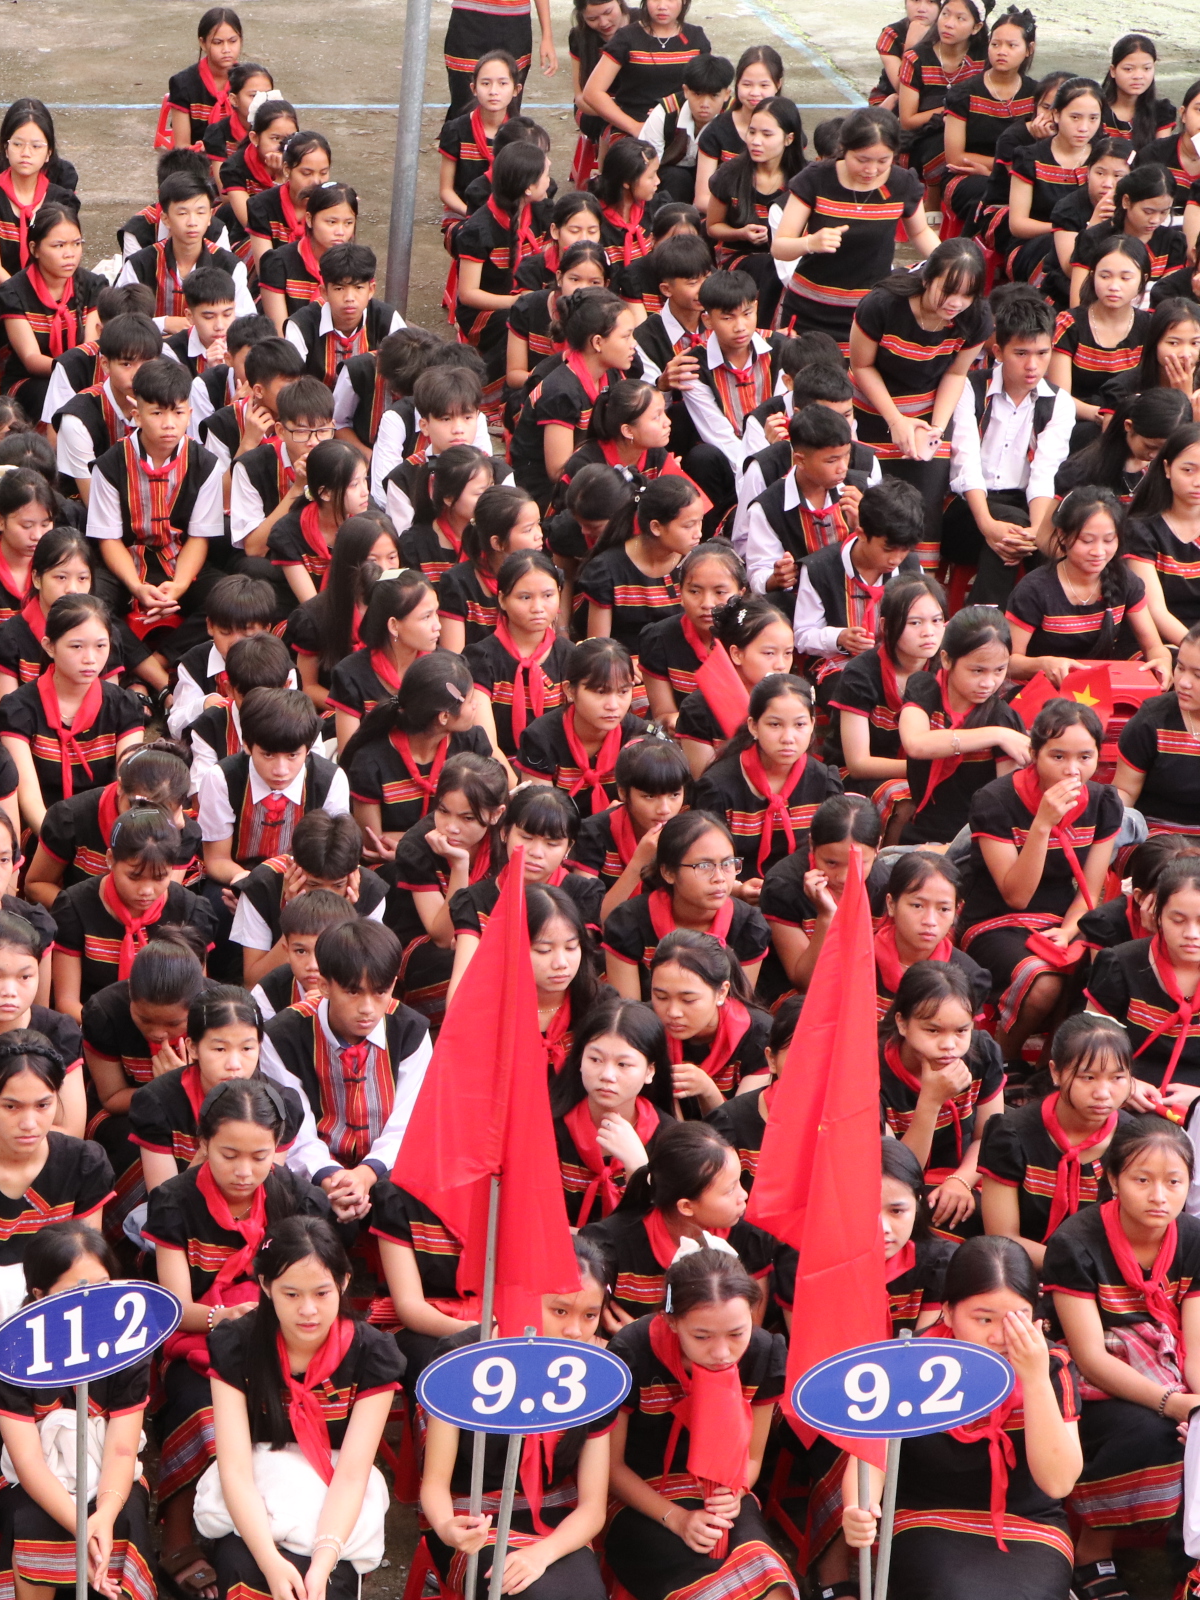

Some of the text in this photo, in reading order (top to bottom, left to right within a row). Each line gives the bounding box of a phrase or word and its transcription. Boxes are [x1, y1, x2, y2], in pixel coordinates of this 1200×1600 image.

[25, 1291, 149, 1376] 11.2
[471, 1356, 588, 1415] 9.3
[843, 1355, 965, 1422] 9.2
